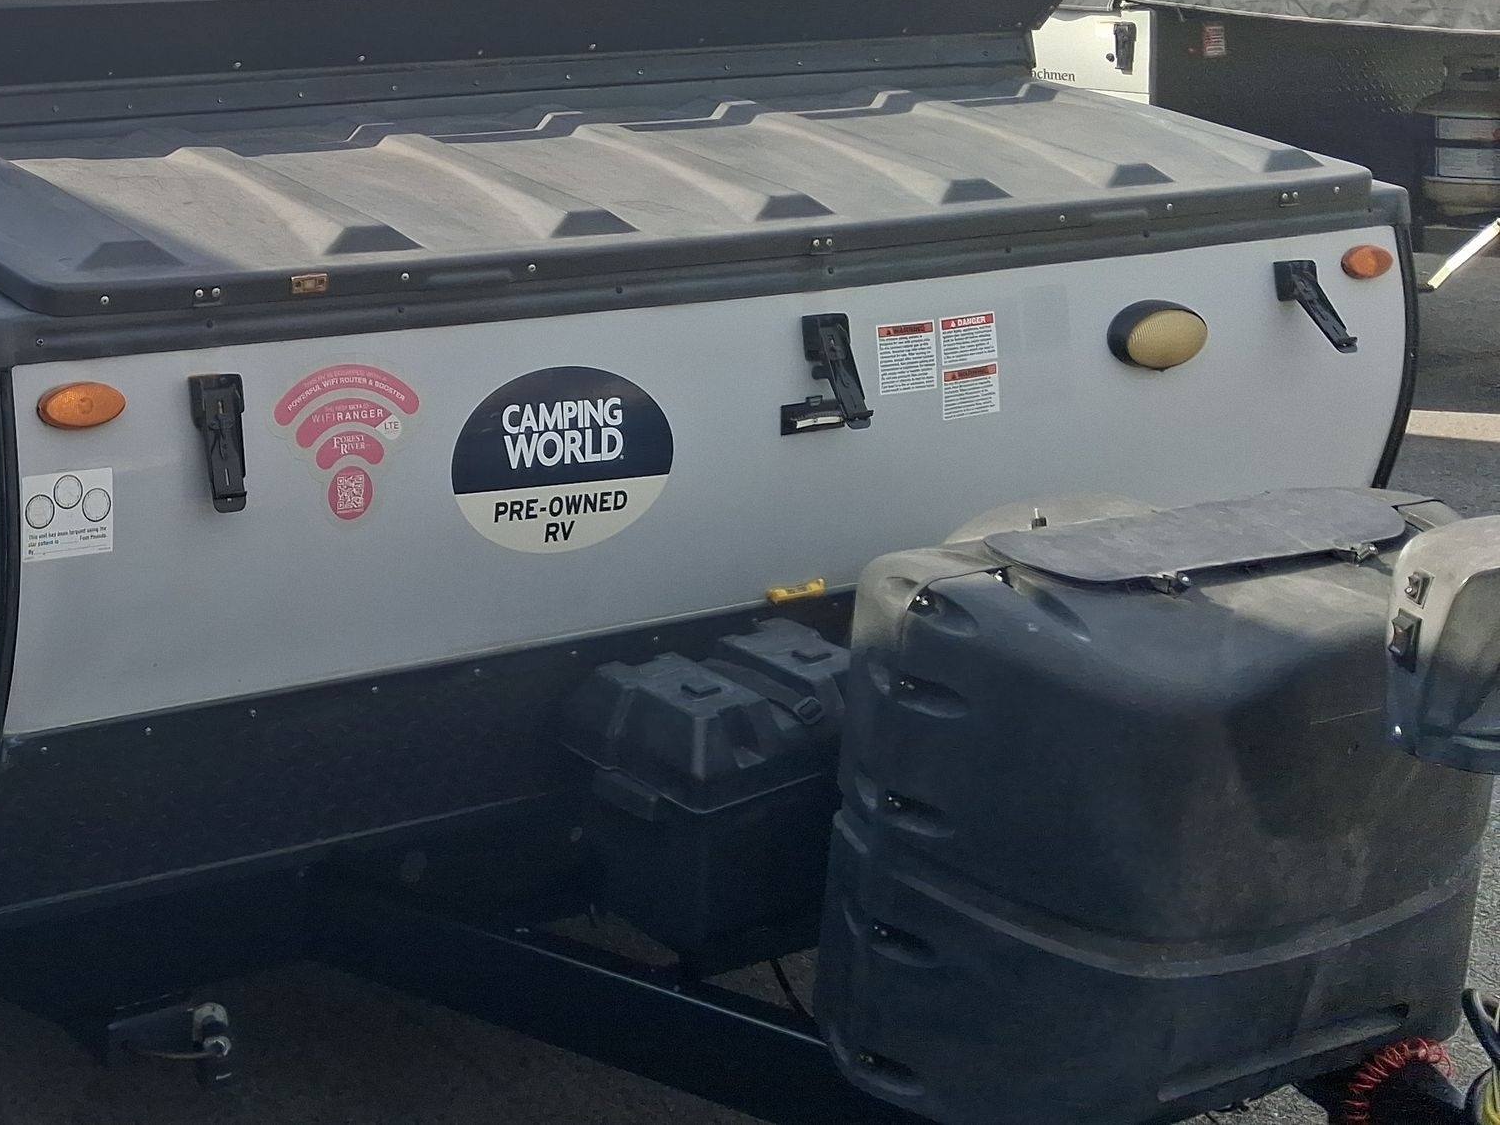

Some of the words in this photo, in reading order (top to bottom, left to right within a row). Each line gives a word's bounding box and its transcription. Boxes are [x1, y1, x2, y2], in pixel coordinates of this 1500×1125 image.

[957, 316, 986, 327] DANGER
[287, 385, 322, 411] POWERFUL
[339, 376, 368, 384] ROUTER
[374, 380, 405, 402] BOOSTER
[384, 421, 399, 430] LTE
[502, 397, 623, 434] CAMPING
[332, 435, 365, 449] FOREST
[340, 442, 366, 455] RIVER
[503, 426, 624, 470] WORLD
[494, 490, 628, 523] PRE-OWNED
[544, 520, 576, 543] RV
